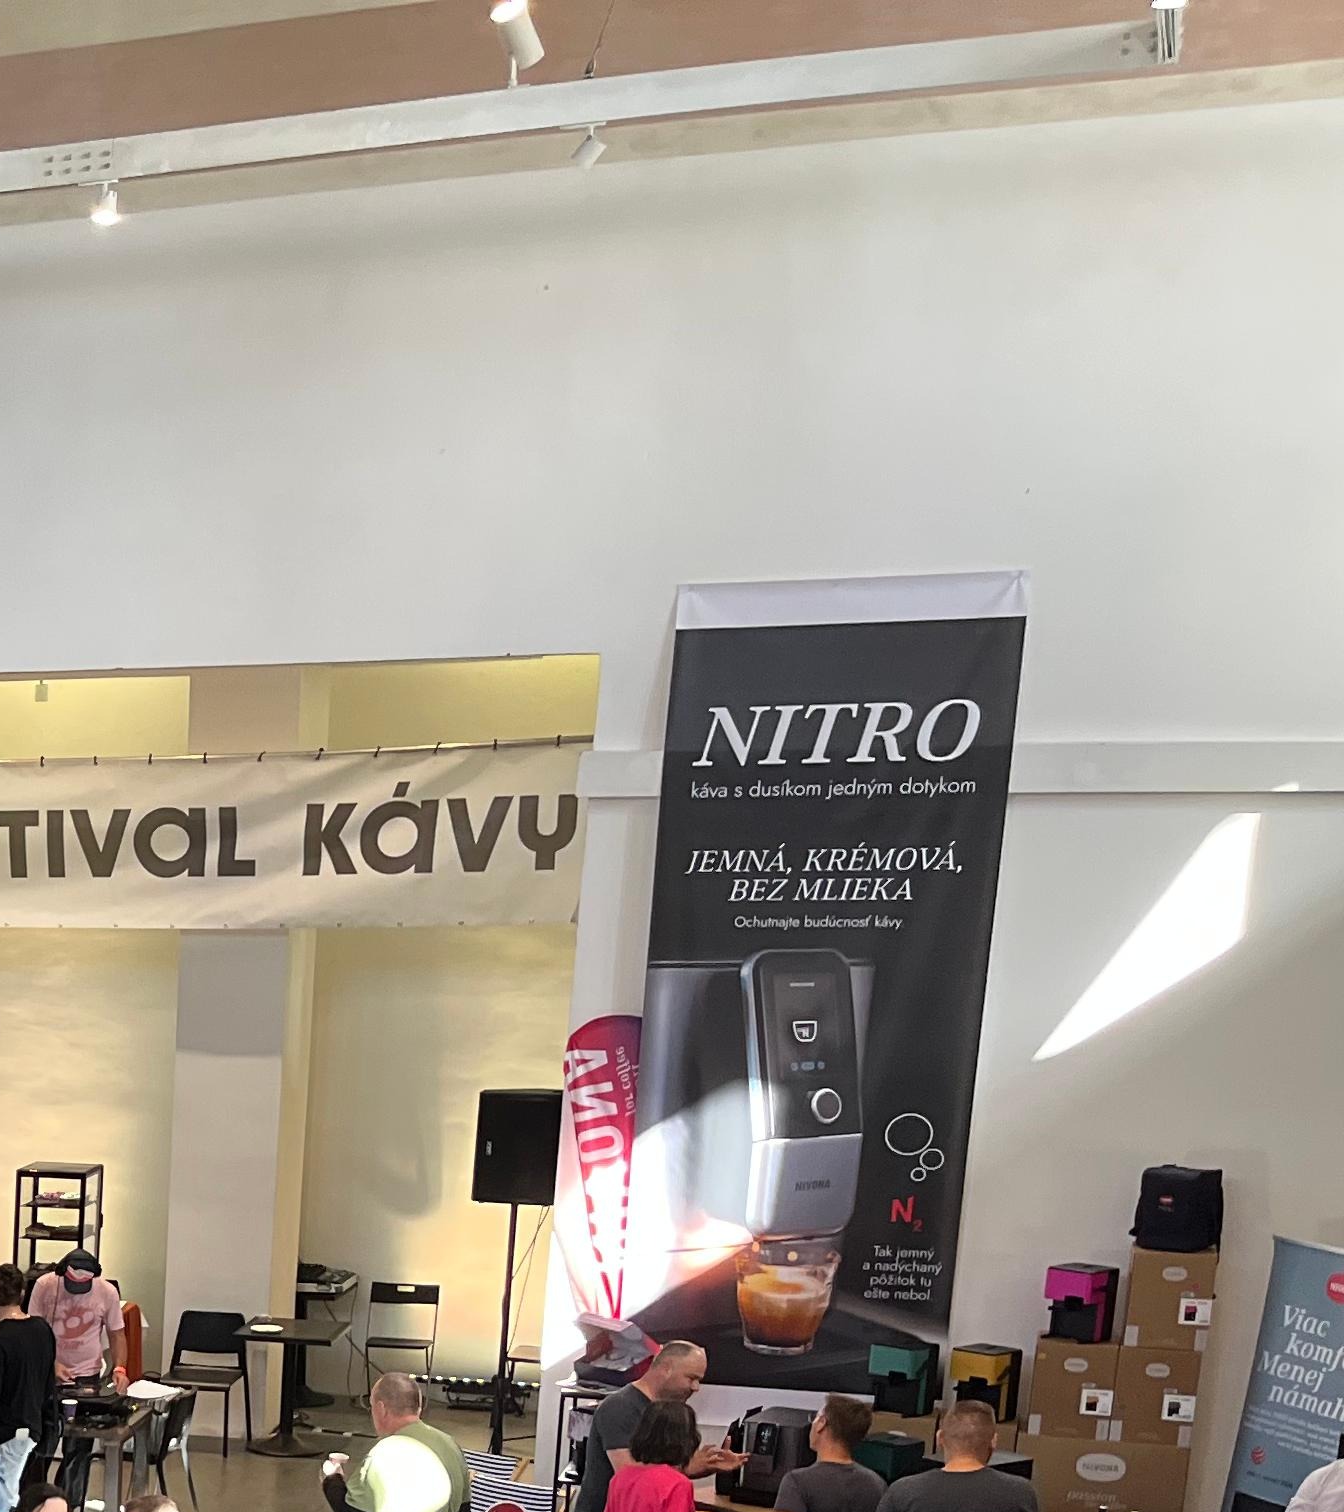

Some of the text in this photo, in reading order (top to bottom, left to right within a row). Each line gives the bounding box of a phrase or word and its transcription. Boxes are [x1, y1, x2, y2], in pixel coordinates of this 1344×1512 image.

[691, 698, 981, 767] NITRO
[691, 775, 977, 801] káva s dusíkom jedným dotykom
[685, 840, 963, 875] JEMNÁ, KRÉMOVÁ,
[727, 877, 914, 902] BEZ MLIEKA
[733, 914, 801, 931] Ochutnajte
[874, 915, 904, 931] kávy
[874, 1245, 935, 1263] Tak jemný
[862, 1259, 943, 1276] a nadýchaný
[870, 1273, 932, 1288] pôžitok tu
[863, 1288, 890, 1300] ešte
[1283, 1304, 1331, 1338] Viac
[1257, 1350, 1328, 1393] Menej
